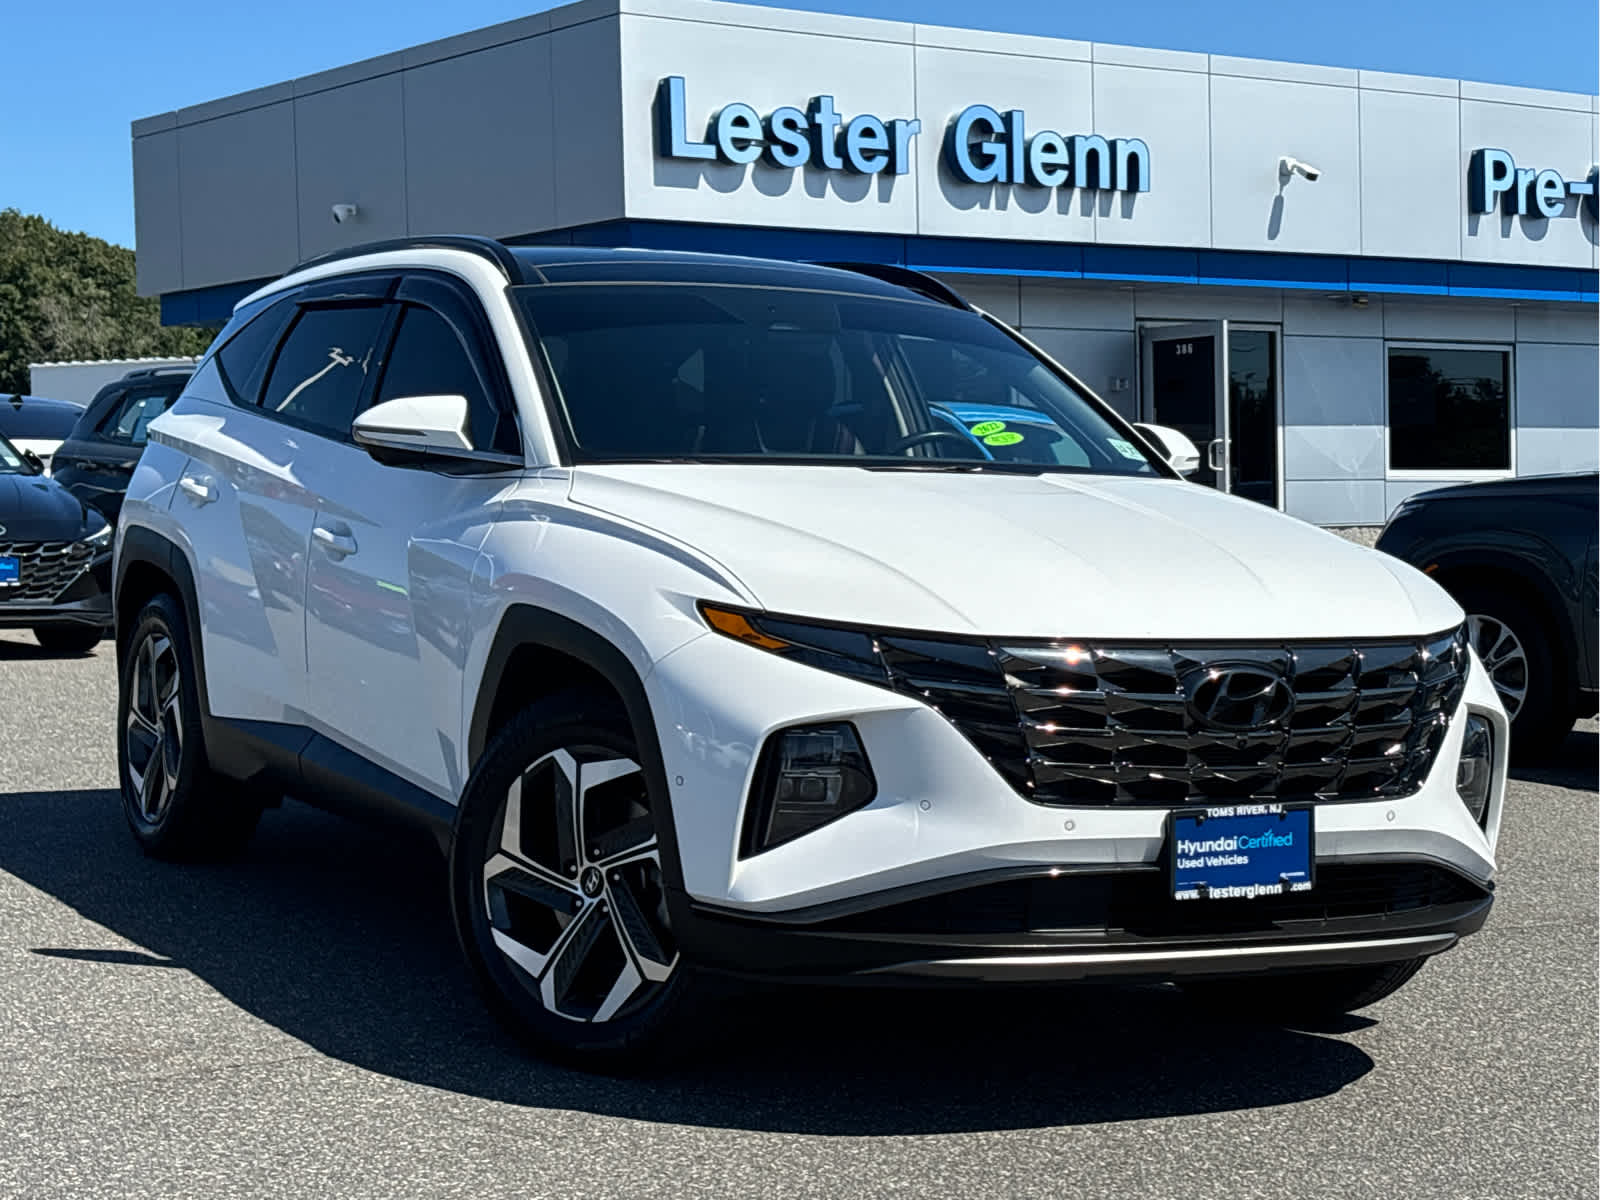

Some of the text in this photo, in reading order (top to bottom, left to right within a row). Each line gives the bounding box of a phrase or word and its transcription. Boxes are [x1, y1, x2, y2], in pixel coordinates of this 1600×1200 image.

[659, 76, 1151, 193] Lester Glenn
[1468, 148, 1599, 220] Pre-
[1176, 343, 1193, 355] 386
[1206, 807, 1234, 818] TOMS
[1269, 803, 1283, 814] NJ
[1177, 829, 1293, 856] Hyundai Certified
[1177, 855, 1249, 869] Used Vehicles
